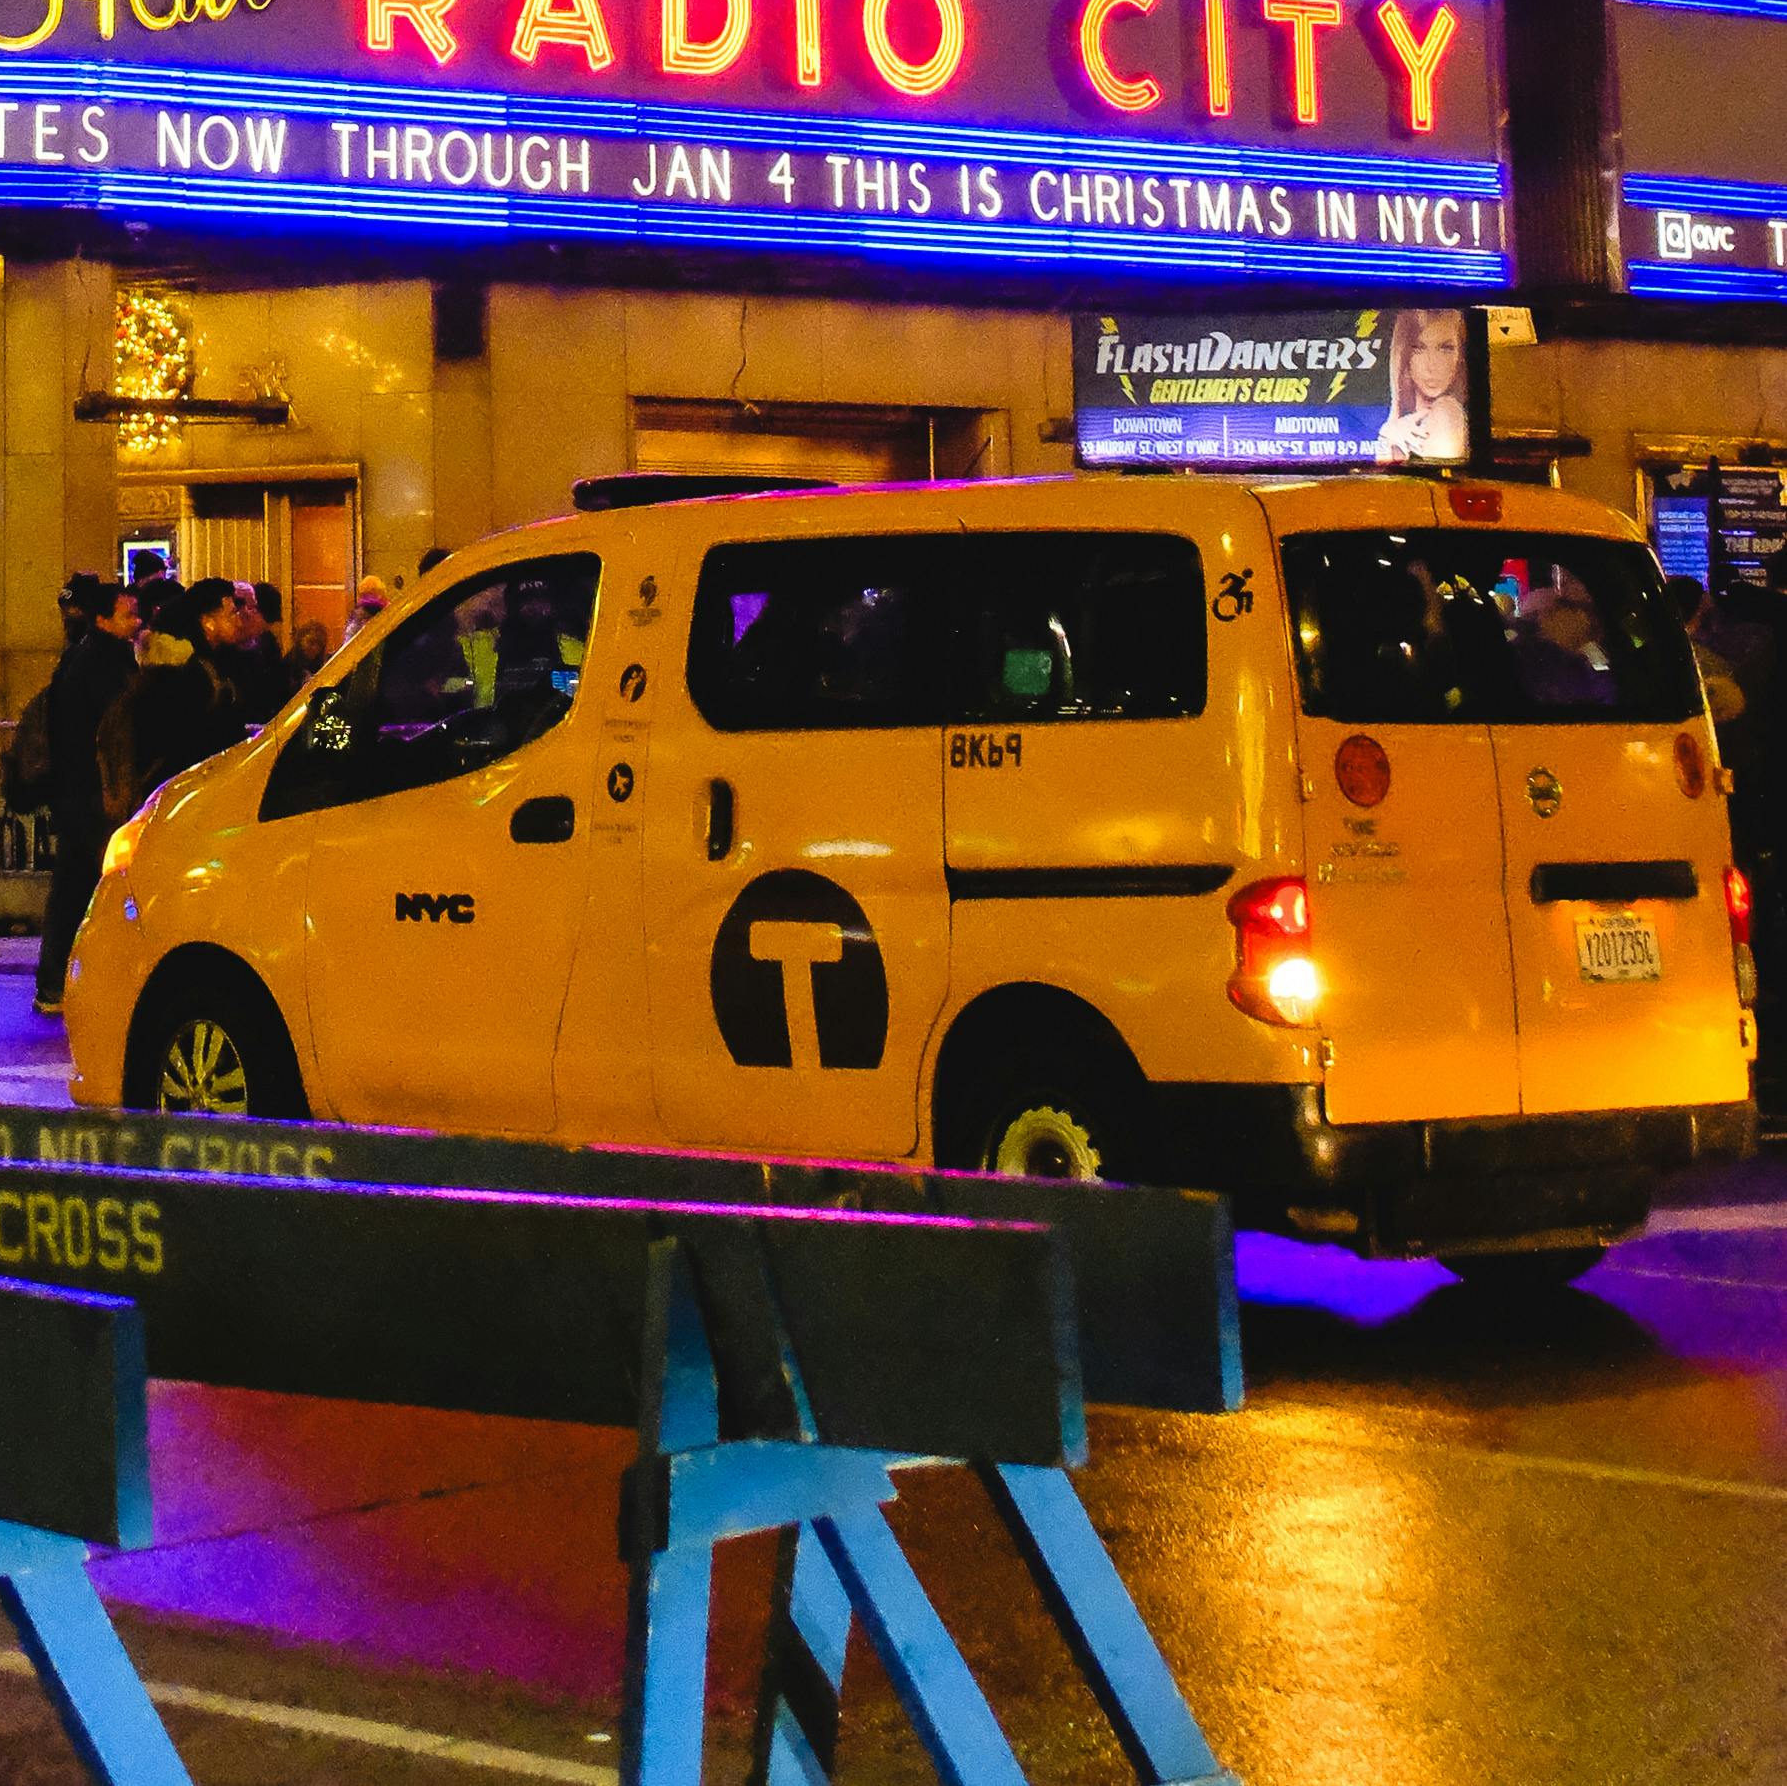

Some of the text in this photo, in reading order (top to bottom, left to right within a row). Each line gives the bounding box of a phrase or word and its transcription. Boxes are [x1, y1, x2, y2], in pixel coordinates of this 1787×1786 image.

[157, 112, 287, 174] NOW
[331, 122, 591, 193] THROUGH
[632, 143, 733, 202] JAN
[767, 153, 796, 204] 4
[825, 153, 932, 214] THIS
[959, 164, 1004, 219] IS
[1029, 173, 1292, 239] CHRISTMAS
[1316, 190, 1358, 241] IN
[1378, 195, 1483, 247] NYC!
[1691, 224, 1735, 251] QVC
[1150, 376, 1310, 404] GENTLEMEN'S CLUBS
[1112, 417, 1183, 434] DOWNTOWN
[1273, 416, 1340, 434] MIDTOWN
[1094, 440, 1137, 455] MURRAY
[395, 892, 476, 923] NYC
